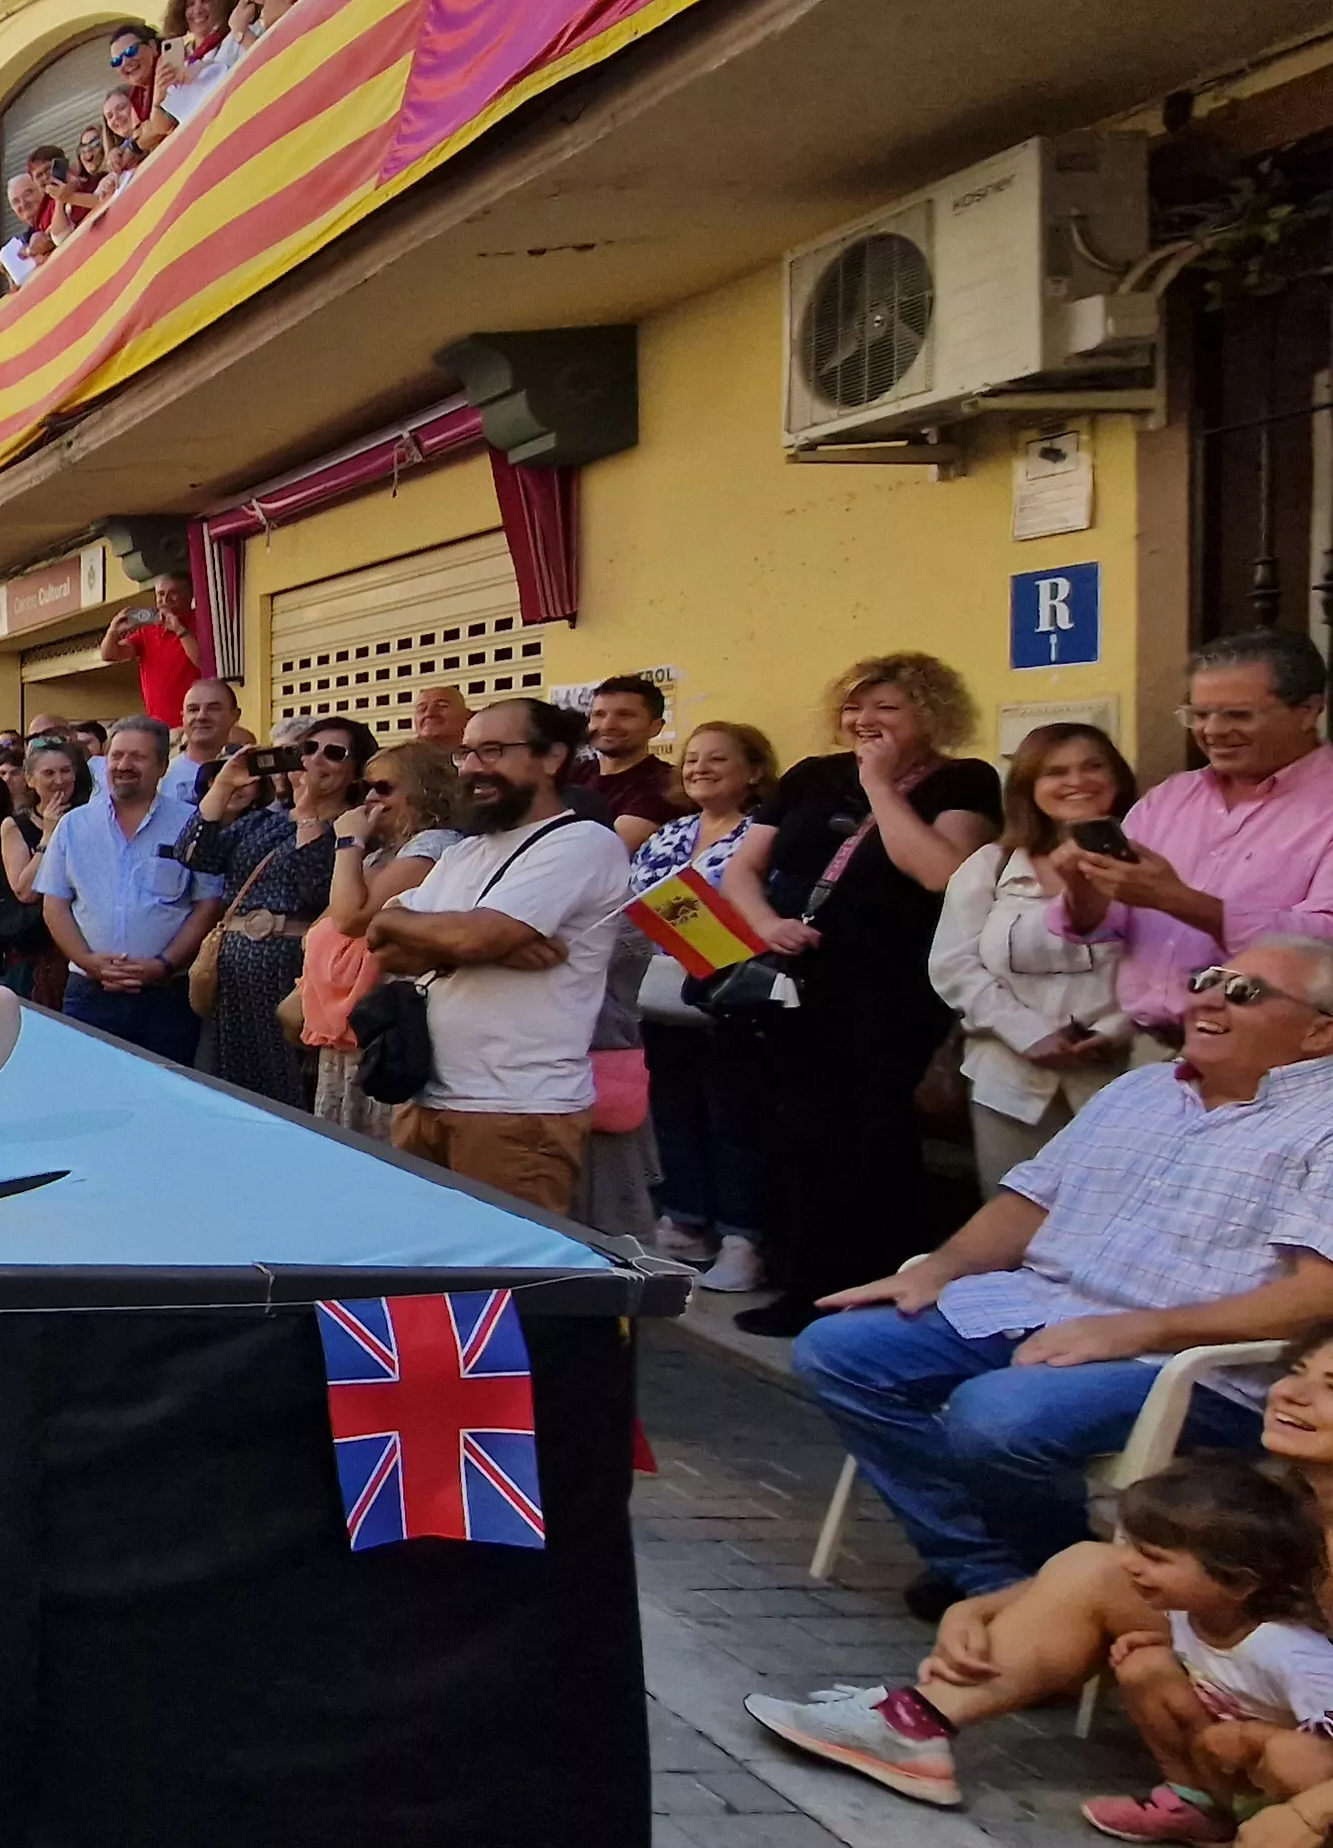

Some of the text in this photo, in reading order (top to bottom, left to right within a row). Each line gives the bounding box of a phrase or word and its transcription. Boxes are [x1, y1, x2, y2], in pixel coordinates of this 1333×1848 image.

[14, 576, 71, 615] Centro Cultural
[1034, 577, 1075, 633] R
